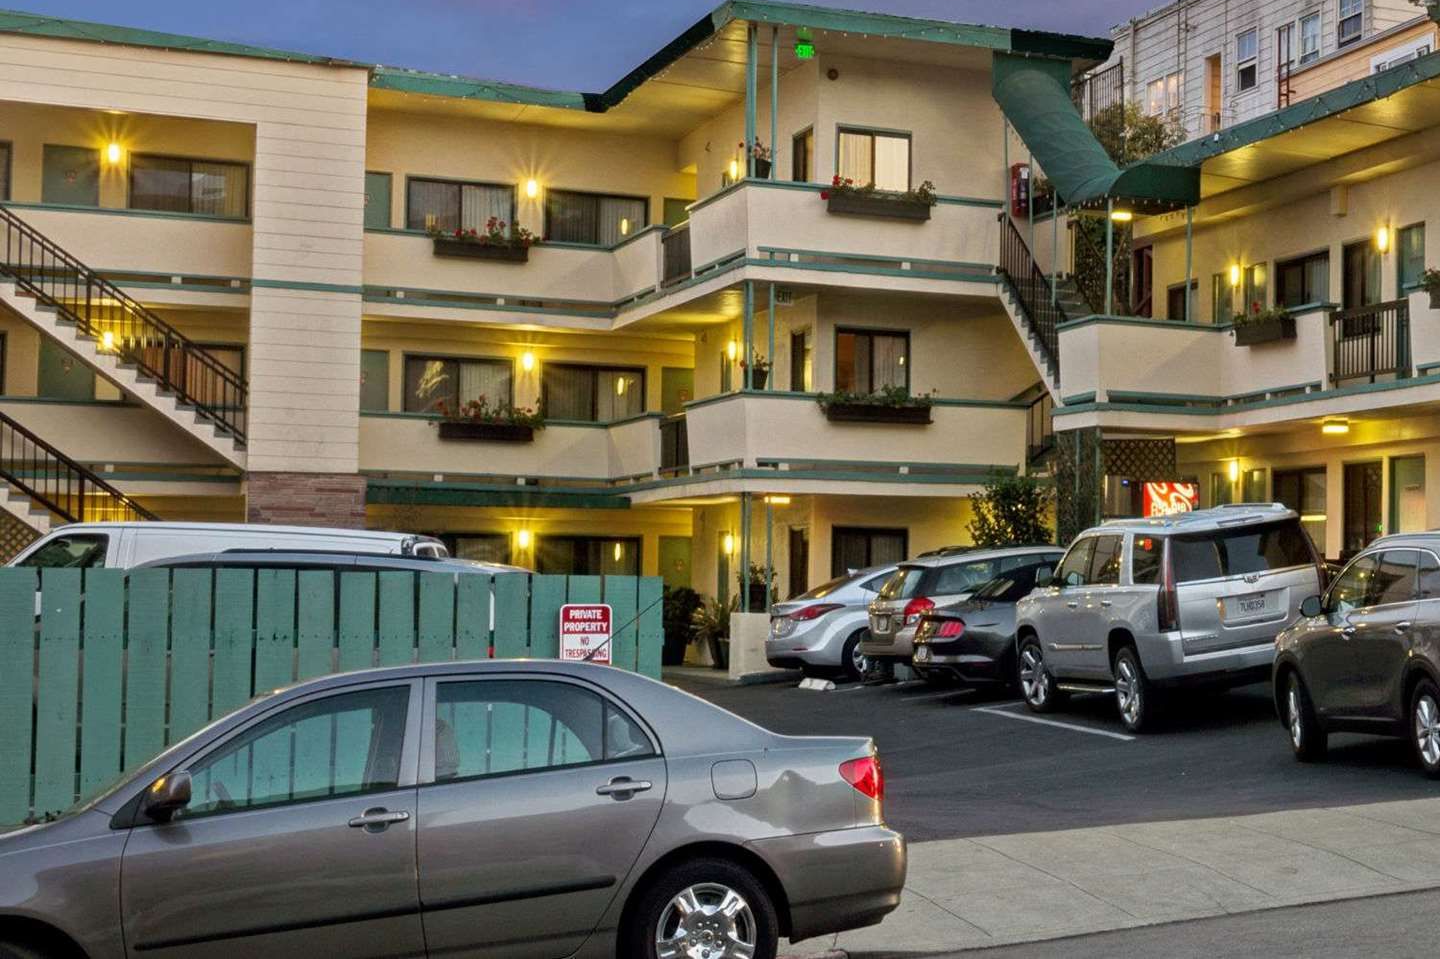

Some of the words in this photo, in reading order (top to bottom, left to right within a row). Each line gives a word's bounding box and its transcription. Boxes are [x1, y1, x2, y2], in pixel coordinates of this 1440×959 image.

[569, 609, 603, 620] PRIVATE
[564, 621, 608, 632] PROPERTY
[581, 636, 590, 646] NO
